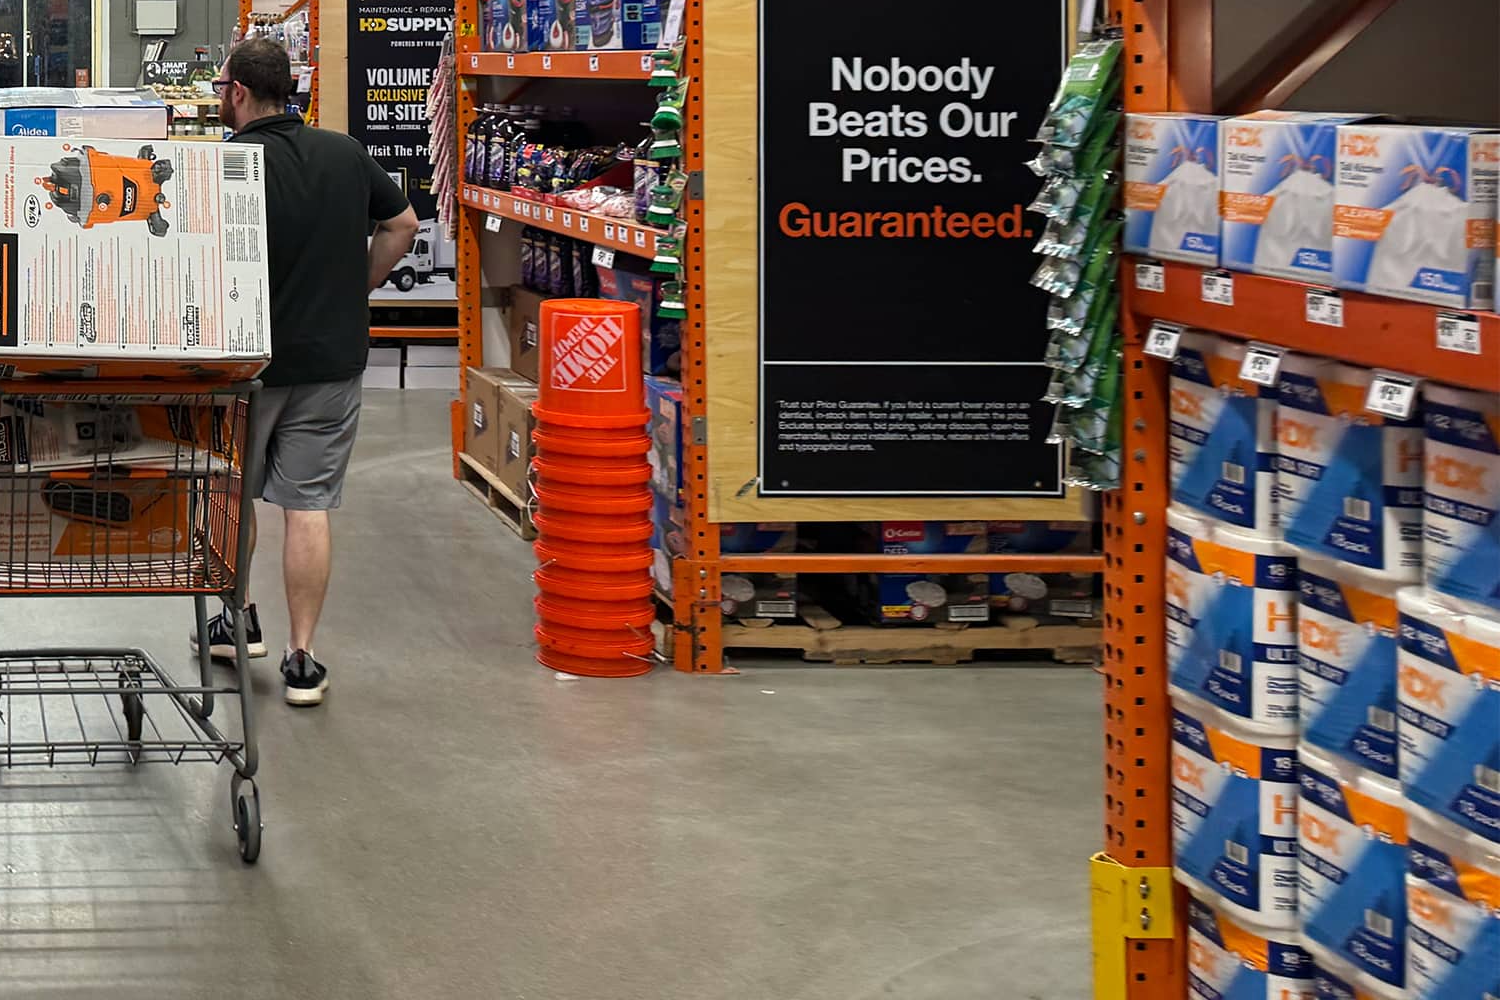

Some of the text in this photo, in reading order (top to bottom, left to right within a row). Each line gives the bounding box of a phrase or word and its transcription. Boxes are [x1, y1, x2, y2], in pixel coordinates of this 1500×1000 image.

[359, 6, 447, 14] MAINTENANCE REPAIR
[366, 68, 431, 87] VOLUME
[831, 57, 995, 100] Nobody
[366, 89, 425, 102] EXCLUSIVE
[366, 103, 427, 121] ON-SITE
[808, 102, 1018, 138] Beats Our
[367, 144, 391, 157] Visit
[393, 144, 413, 157] The
[1339, 133, 1380, 158] HDX
[842, 148, 983, 183] Prices.
[778, 202, 1034, 239] Guaranteed.
[552, 316, 596, 361] DEPOT
[555, 316, 623, 387] HOME
[585, 353, 619, 384] THE
